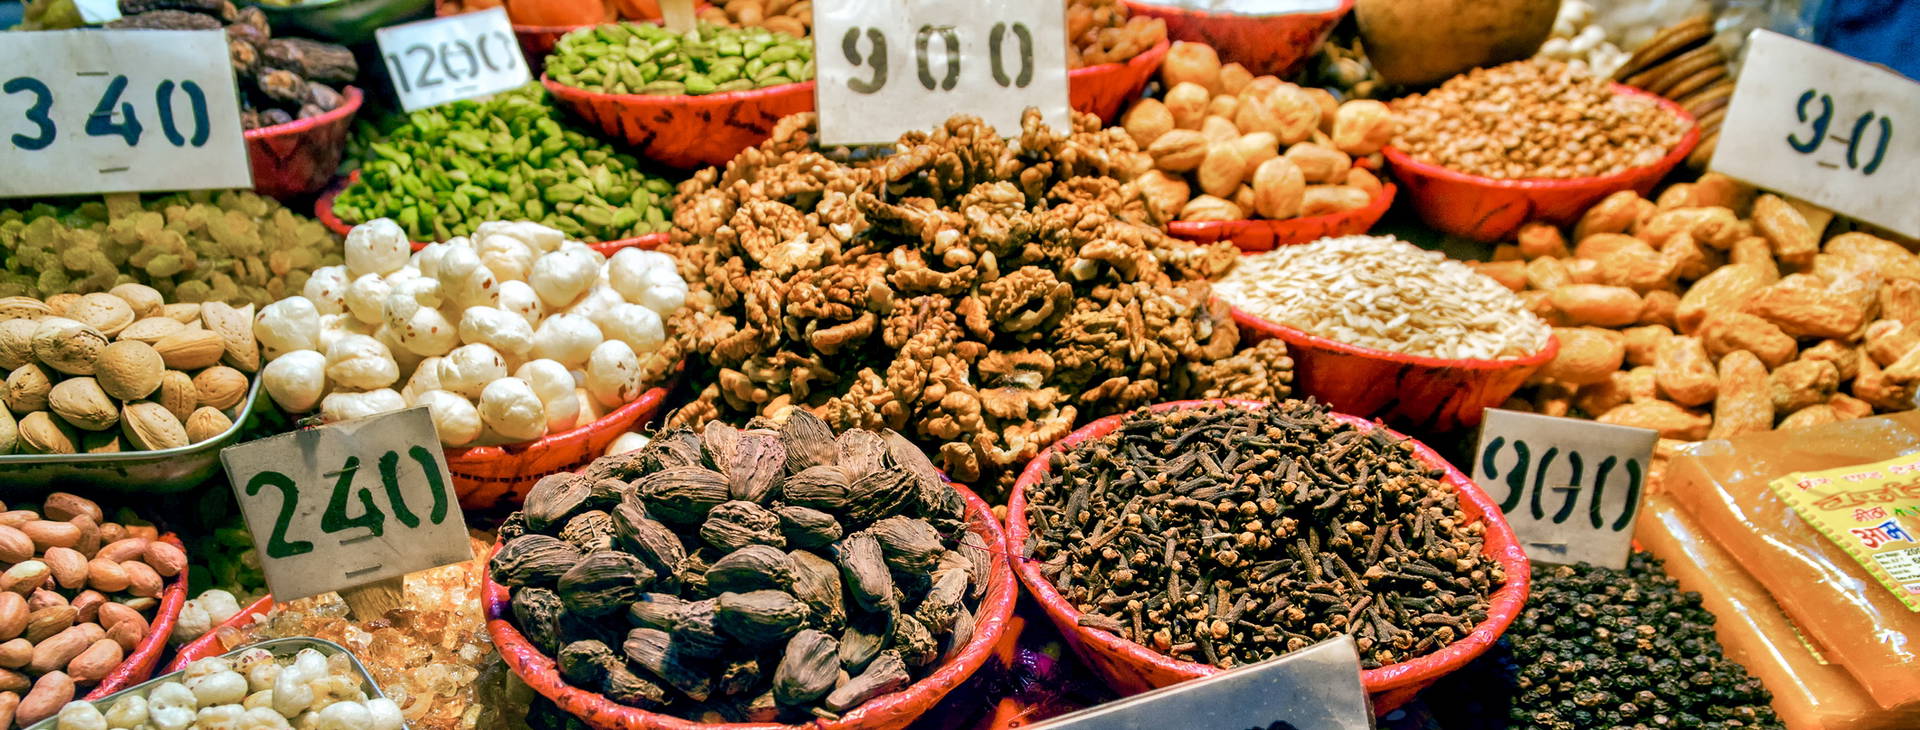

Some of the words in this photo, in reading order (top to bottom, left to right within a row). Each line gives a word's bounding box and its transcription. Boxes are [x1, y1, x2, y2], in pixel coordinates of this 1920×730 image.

[389, 31, 516, 93] 1200
[842, 21, 1034, 95] 900
[3, 74, 211, 151] 340
[1787, 88, 1893, 176] 90
[245, 444, 449, 559] 240
[1482, 435, 1642, 532] 900
[1851, 521, 1914, 549] आम
